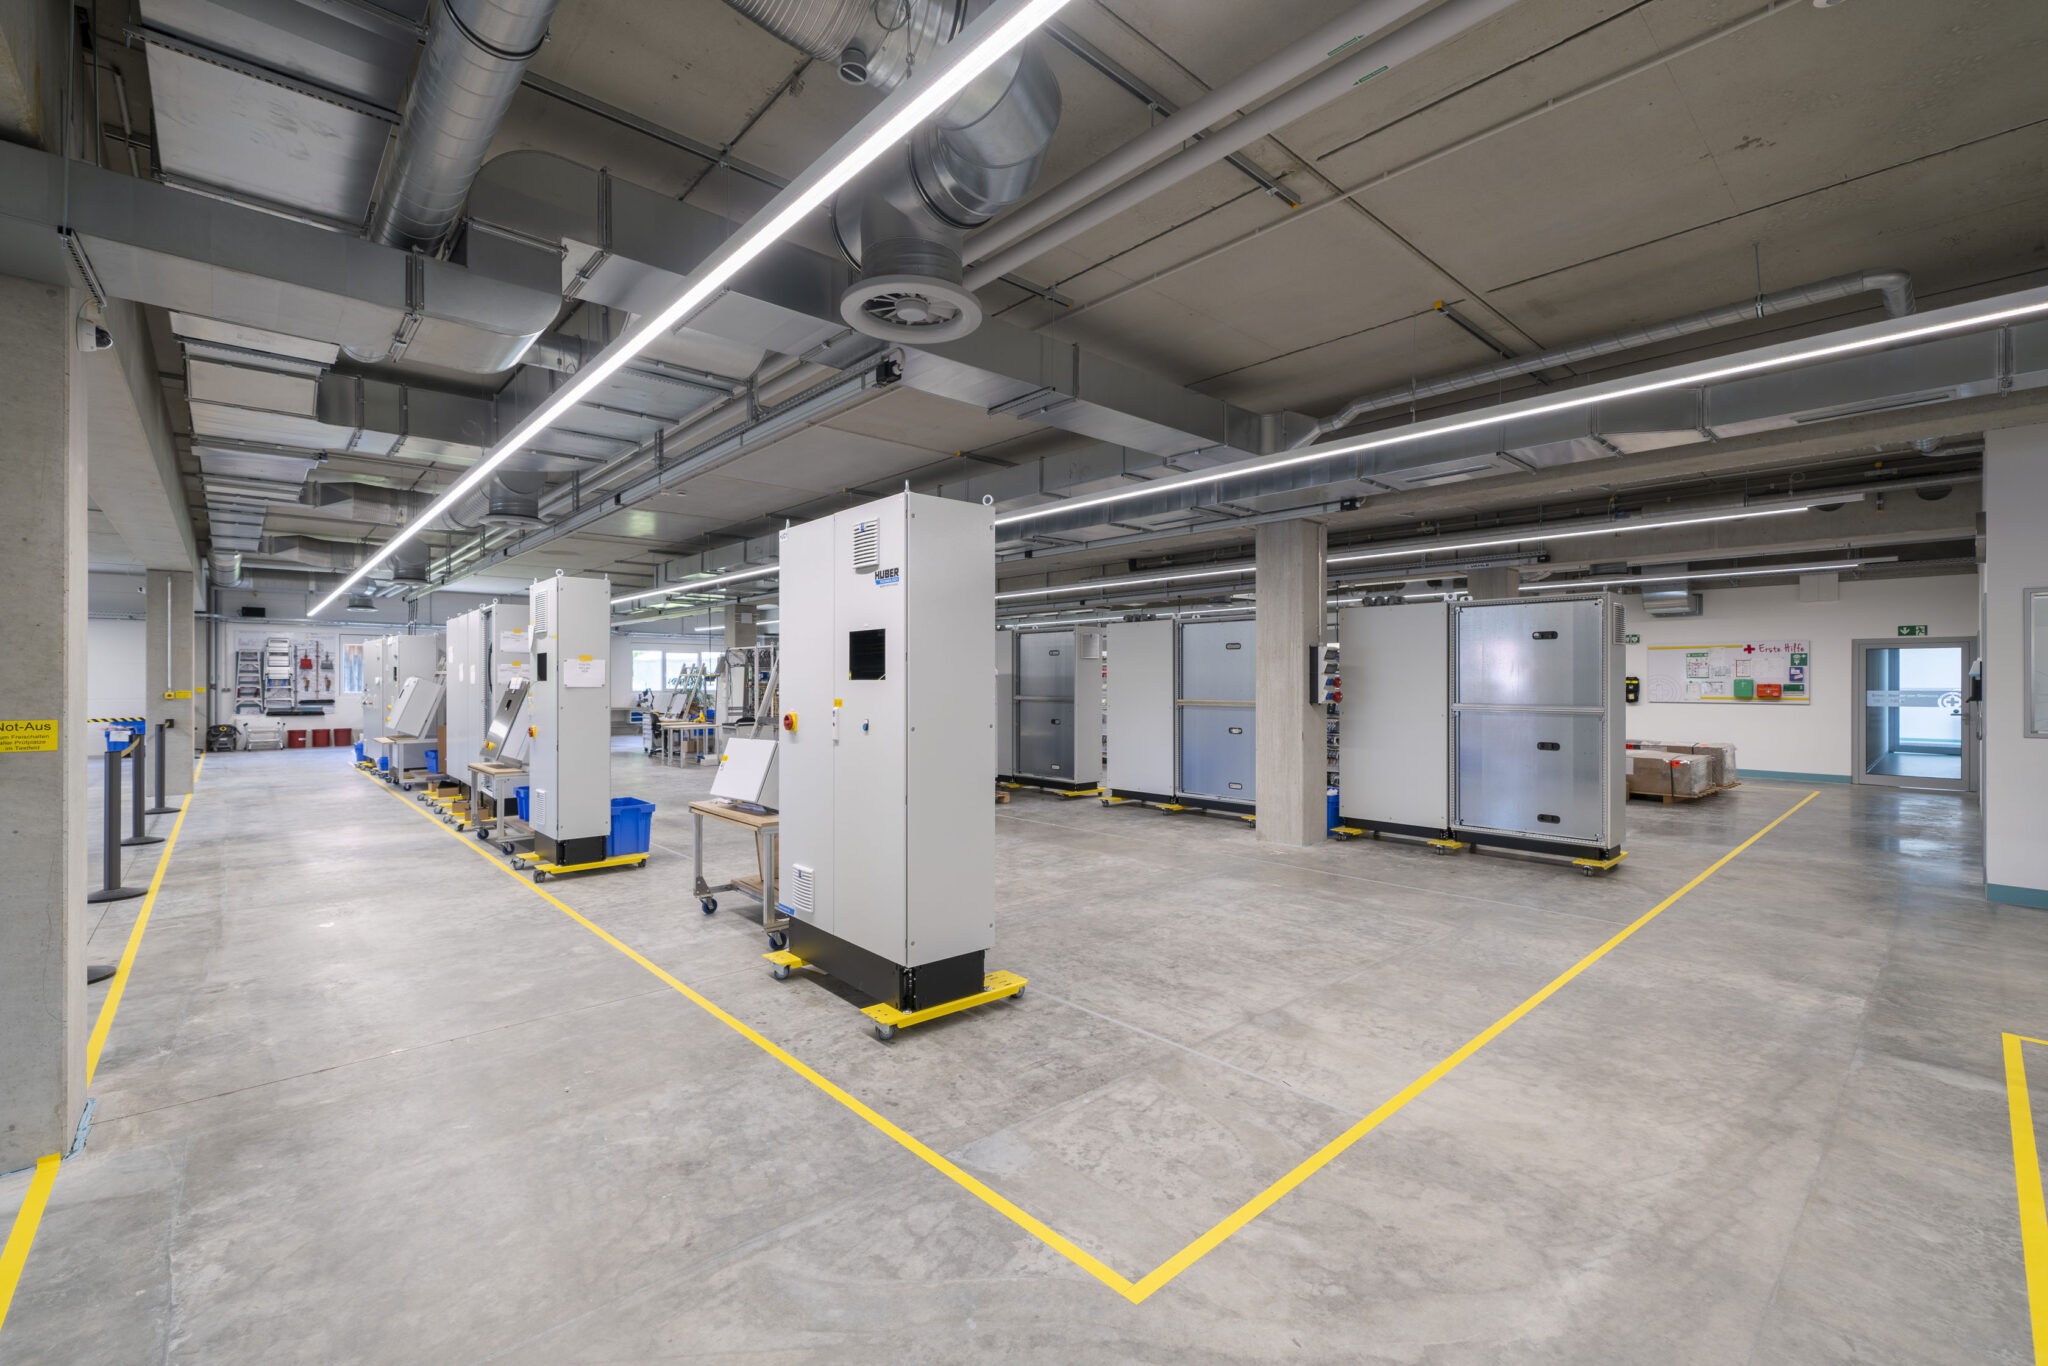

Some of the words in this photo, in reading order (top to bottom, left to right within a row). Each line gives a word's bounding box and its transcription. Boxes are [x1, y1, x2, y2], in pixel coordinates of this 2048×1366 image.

[875, 568, 899, 580] HUBER
[1758, 644, 1780, 652] Erste
[1784, 643, 1804, 652] Hilfe
